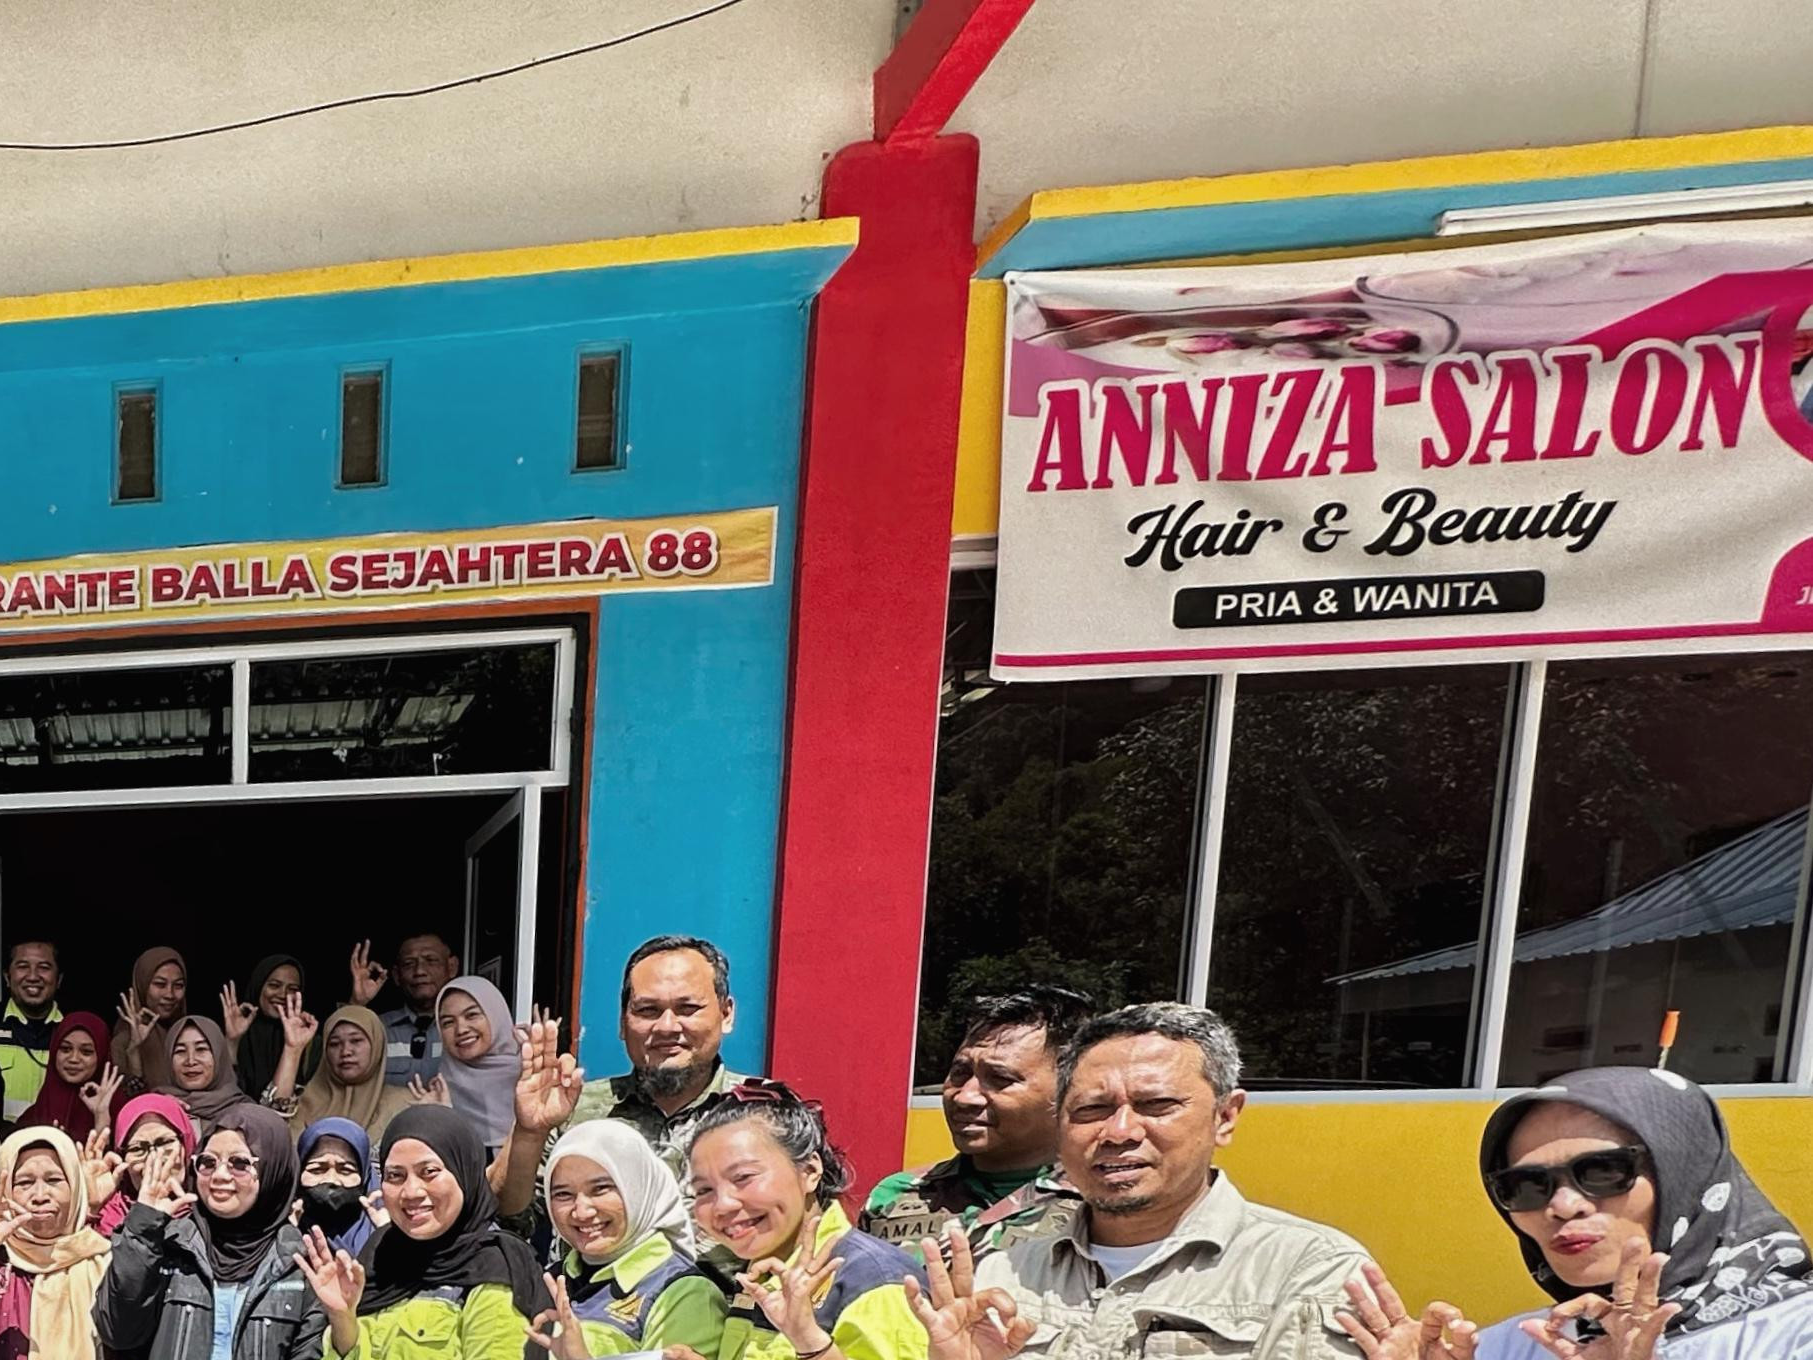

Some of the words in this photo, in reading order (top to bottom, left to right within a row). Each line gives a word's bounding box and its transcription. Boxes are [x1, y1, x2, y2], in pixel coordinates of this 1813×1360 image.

[1025, 363, 1378, 492] ANNIZA
[1420, 337, 1761, 470] SALON
[1123, 499, 1284, 572] Hair
[1302, 502, 1351, 553] &
[1363, 487, 1619, 557] Beauty
[151, 558, 316, 603] BALLA
[328, 536, 633, 593] SEJAHTERA
[646, 530, 713, 572] 88
[1214, 592, 1303, 620] PRIA
[1313, 588, 1340, 616] &
[1352, 581, 1500, 613] WANITA
[878, 1220, 937, 1239] AMAL
